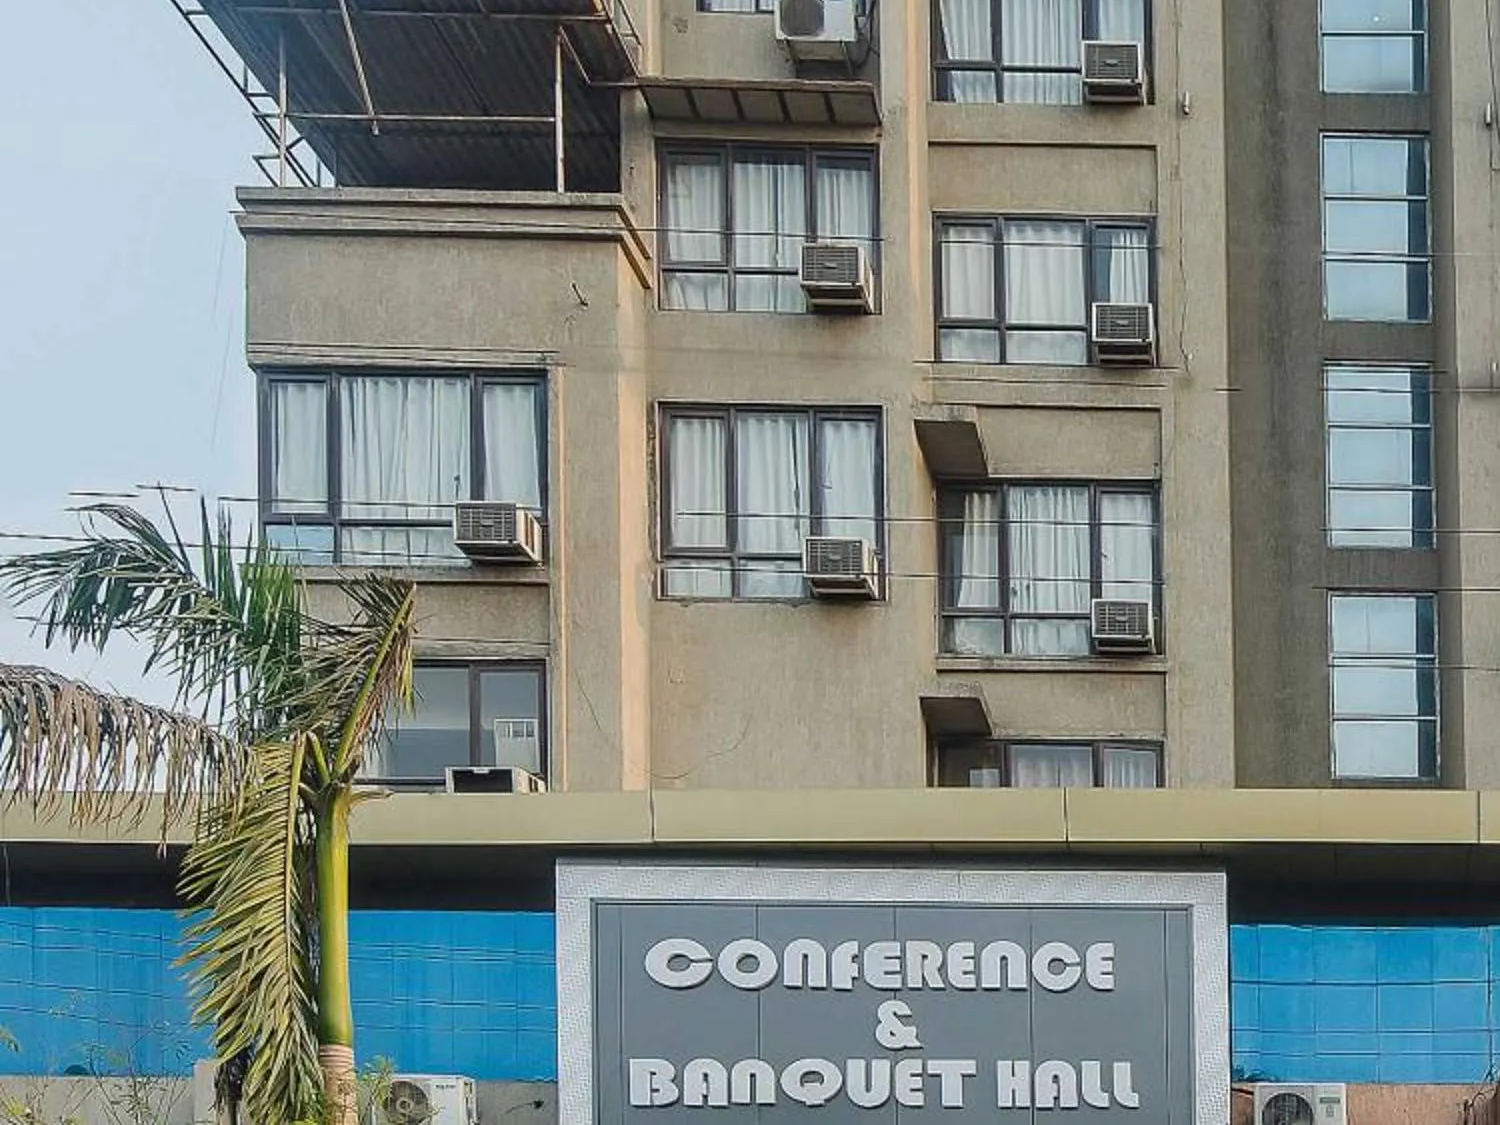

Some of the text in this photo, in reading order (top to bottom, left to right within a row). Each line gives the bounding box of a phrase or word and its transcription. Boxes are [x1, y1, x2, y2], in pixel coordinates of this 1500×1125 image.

[644, 937, 1116, 992] CONFERENCE
[875, 999, 923, 1050] &
[628, 1057, 1141, 1110] BANQUET HALL
